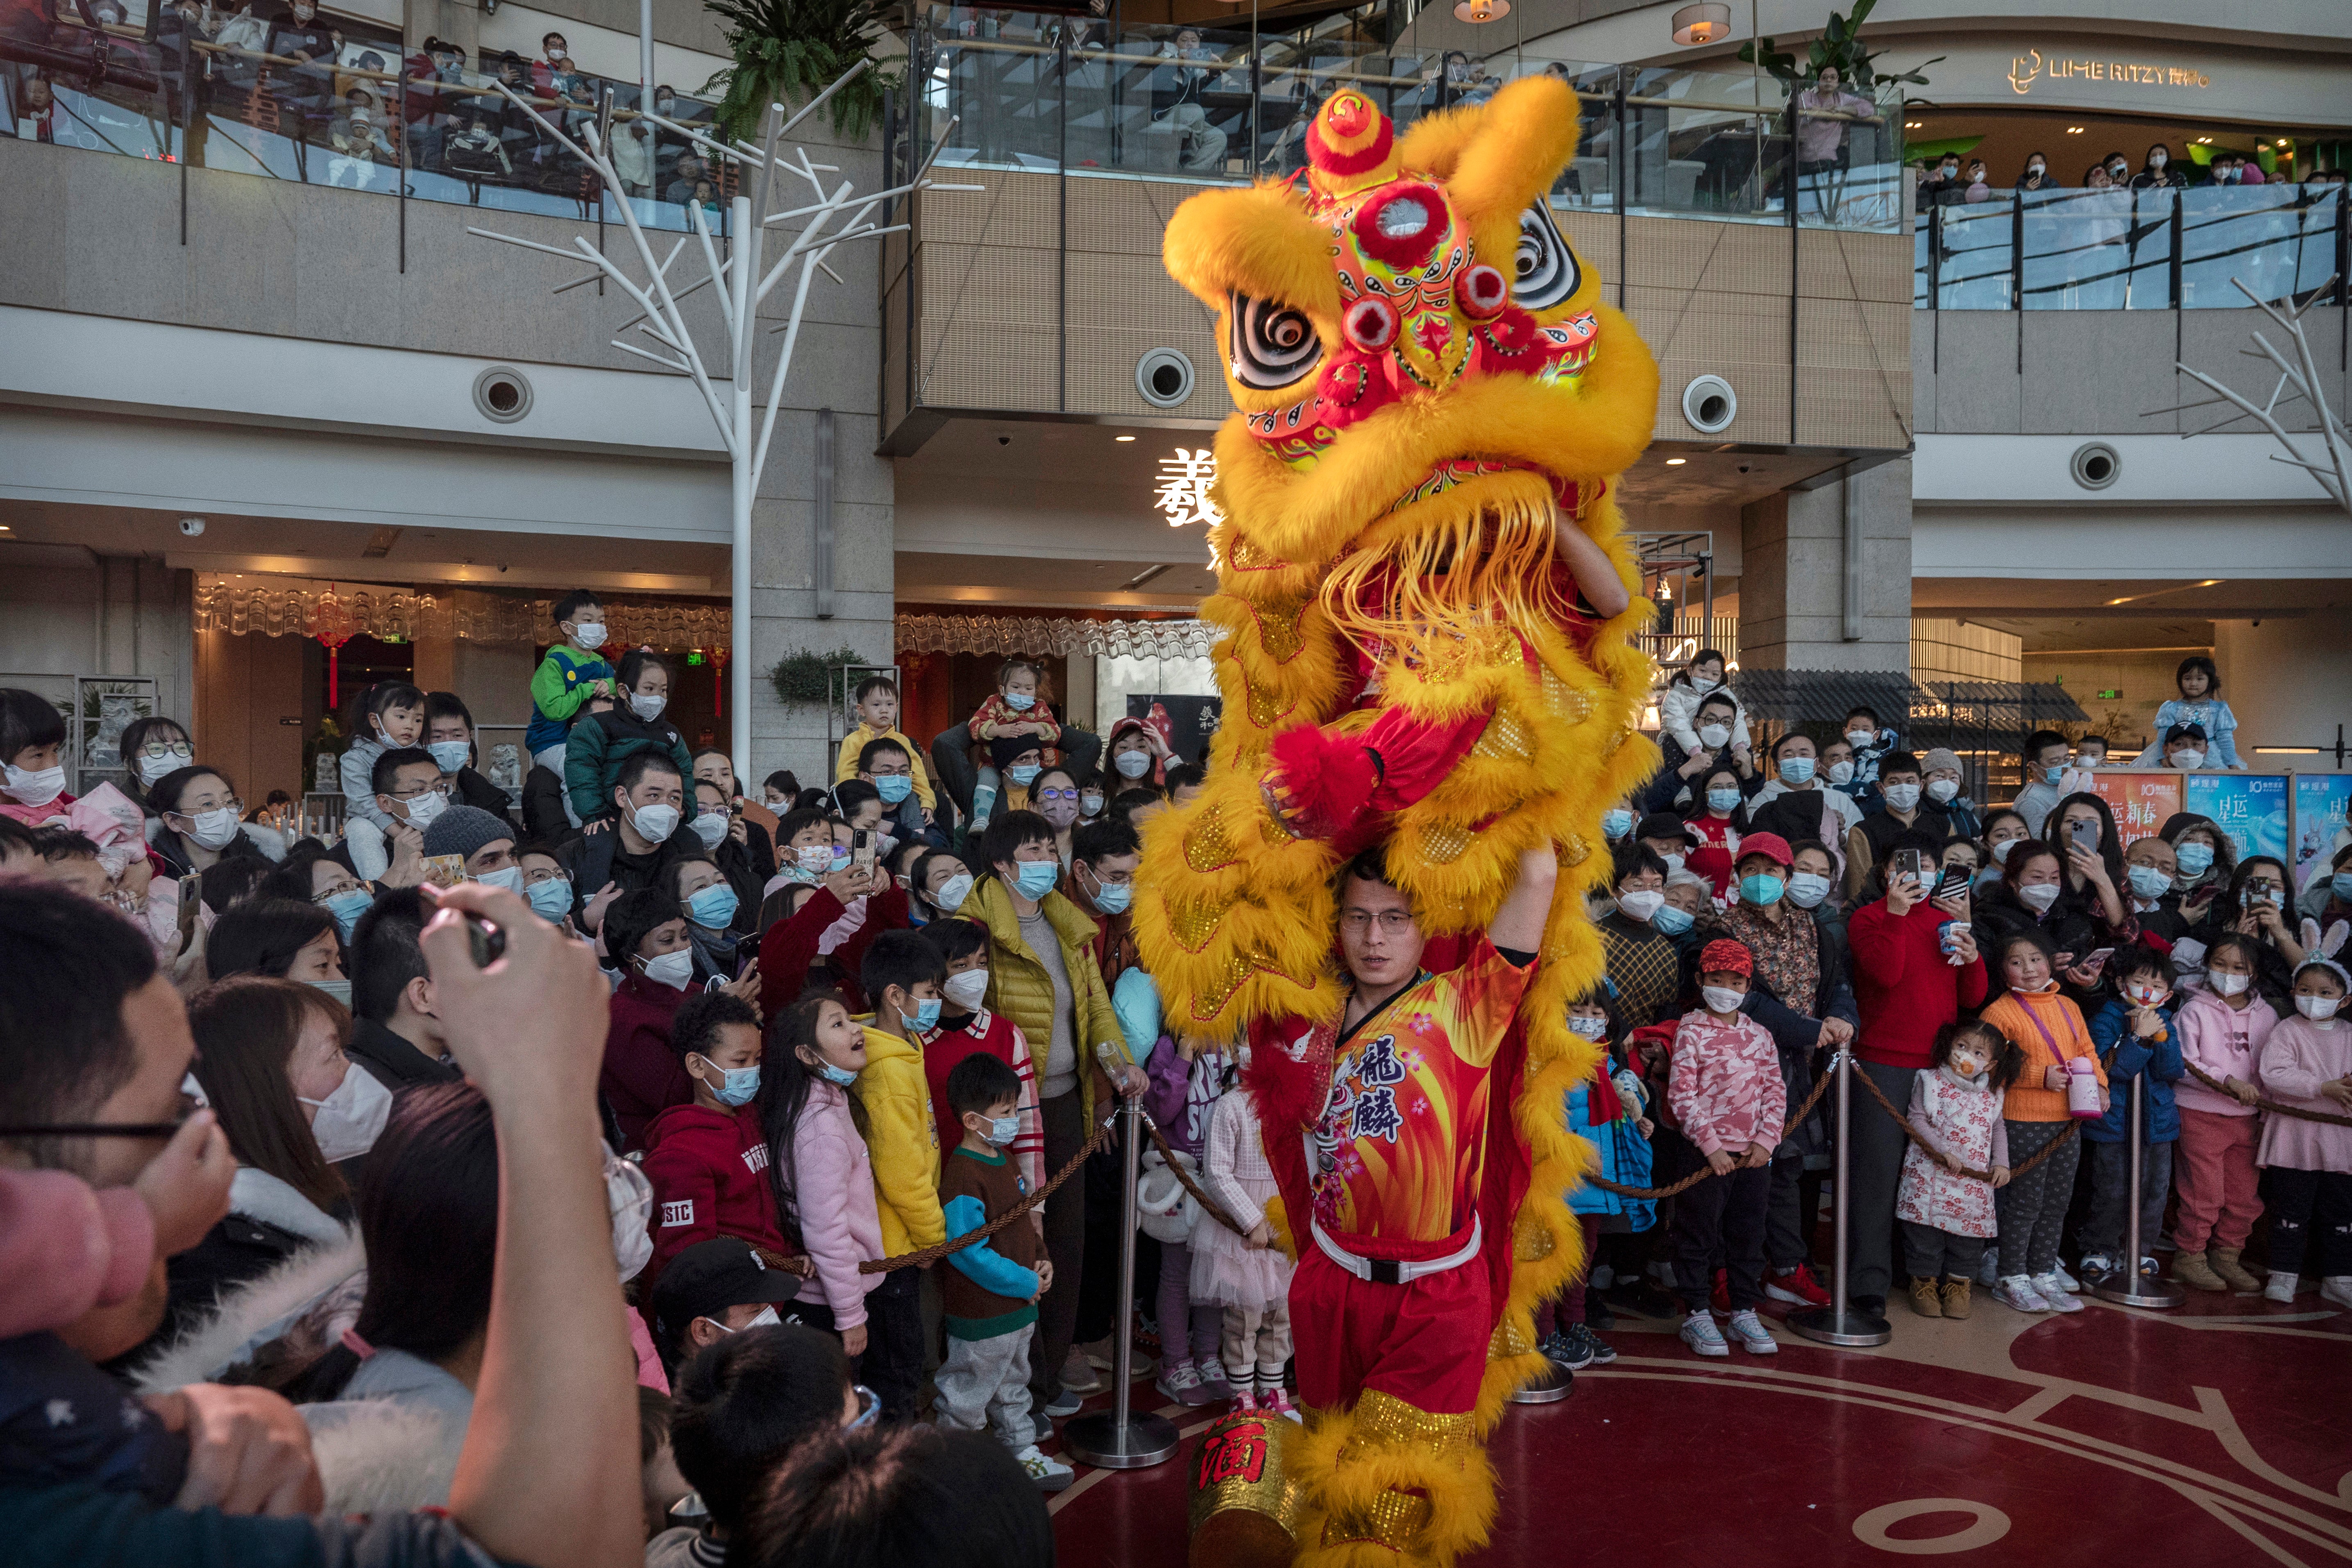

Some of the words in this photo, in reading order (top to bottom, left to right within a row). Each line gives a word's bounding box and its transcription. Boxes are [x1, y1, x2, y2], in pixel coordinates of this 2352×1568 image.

[2050, 59, 2104, 80] LIME
[2110, 63, 2166, 84] RITZY
[2217, 793, 2248, 823] 星运
